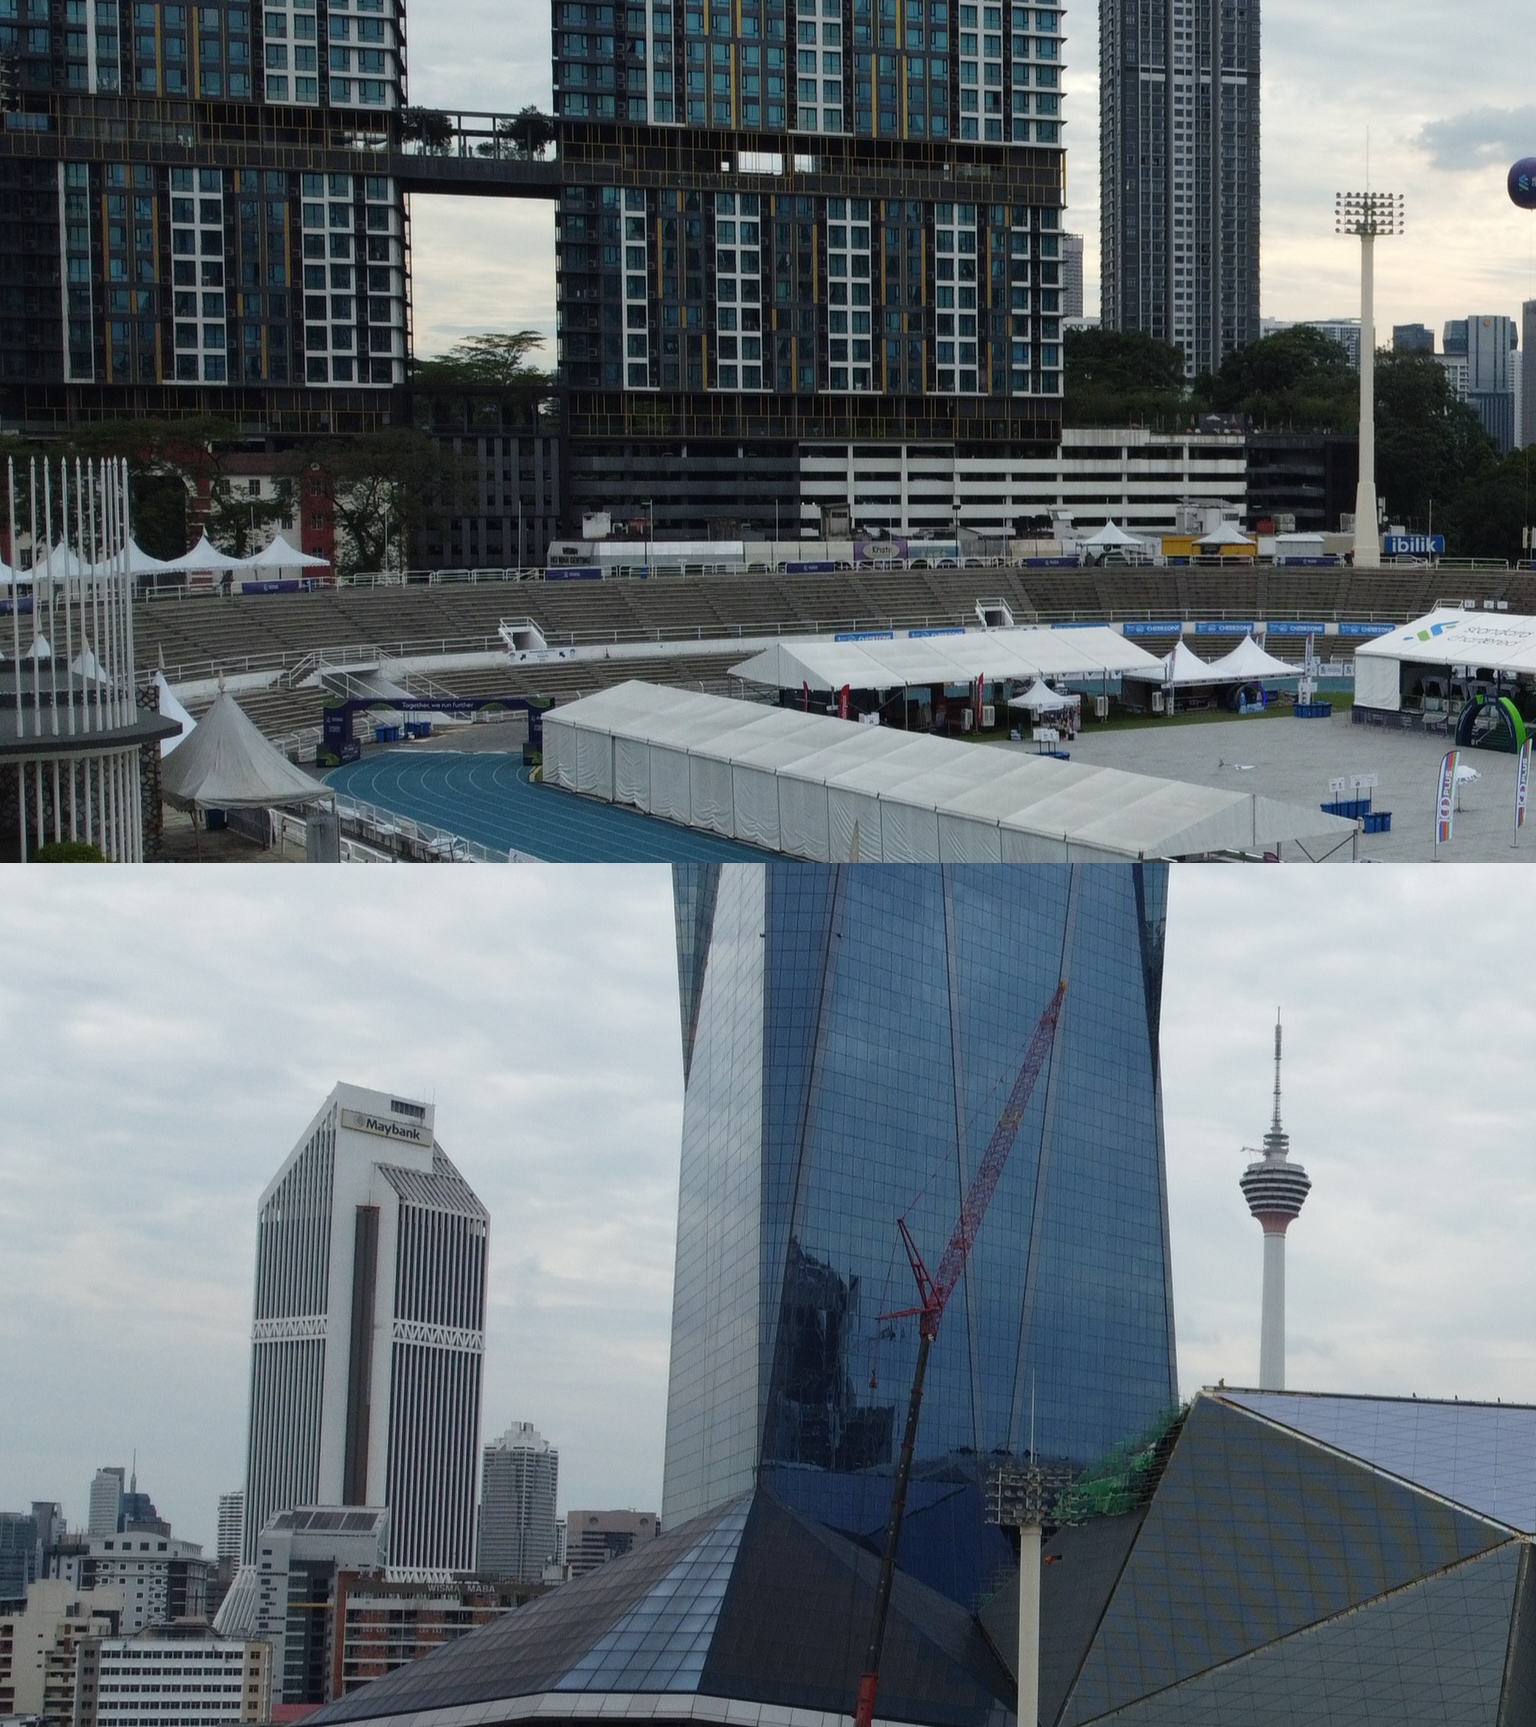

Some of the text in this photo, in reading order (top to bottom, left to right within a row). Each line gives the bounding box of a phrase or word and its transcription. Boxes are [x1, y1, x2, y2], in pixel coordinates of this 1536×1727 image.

[1392, 536, 1436, 553] ibilik
[1443, 770, 1453, 796] PLUS
[365, 1116, 421, 1142] Maybank
[427, 1583, 496, 1594] WISMA MABA
